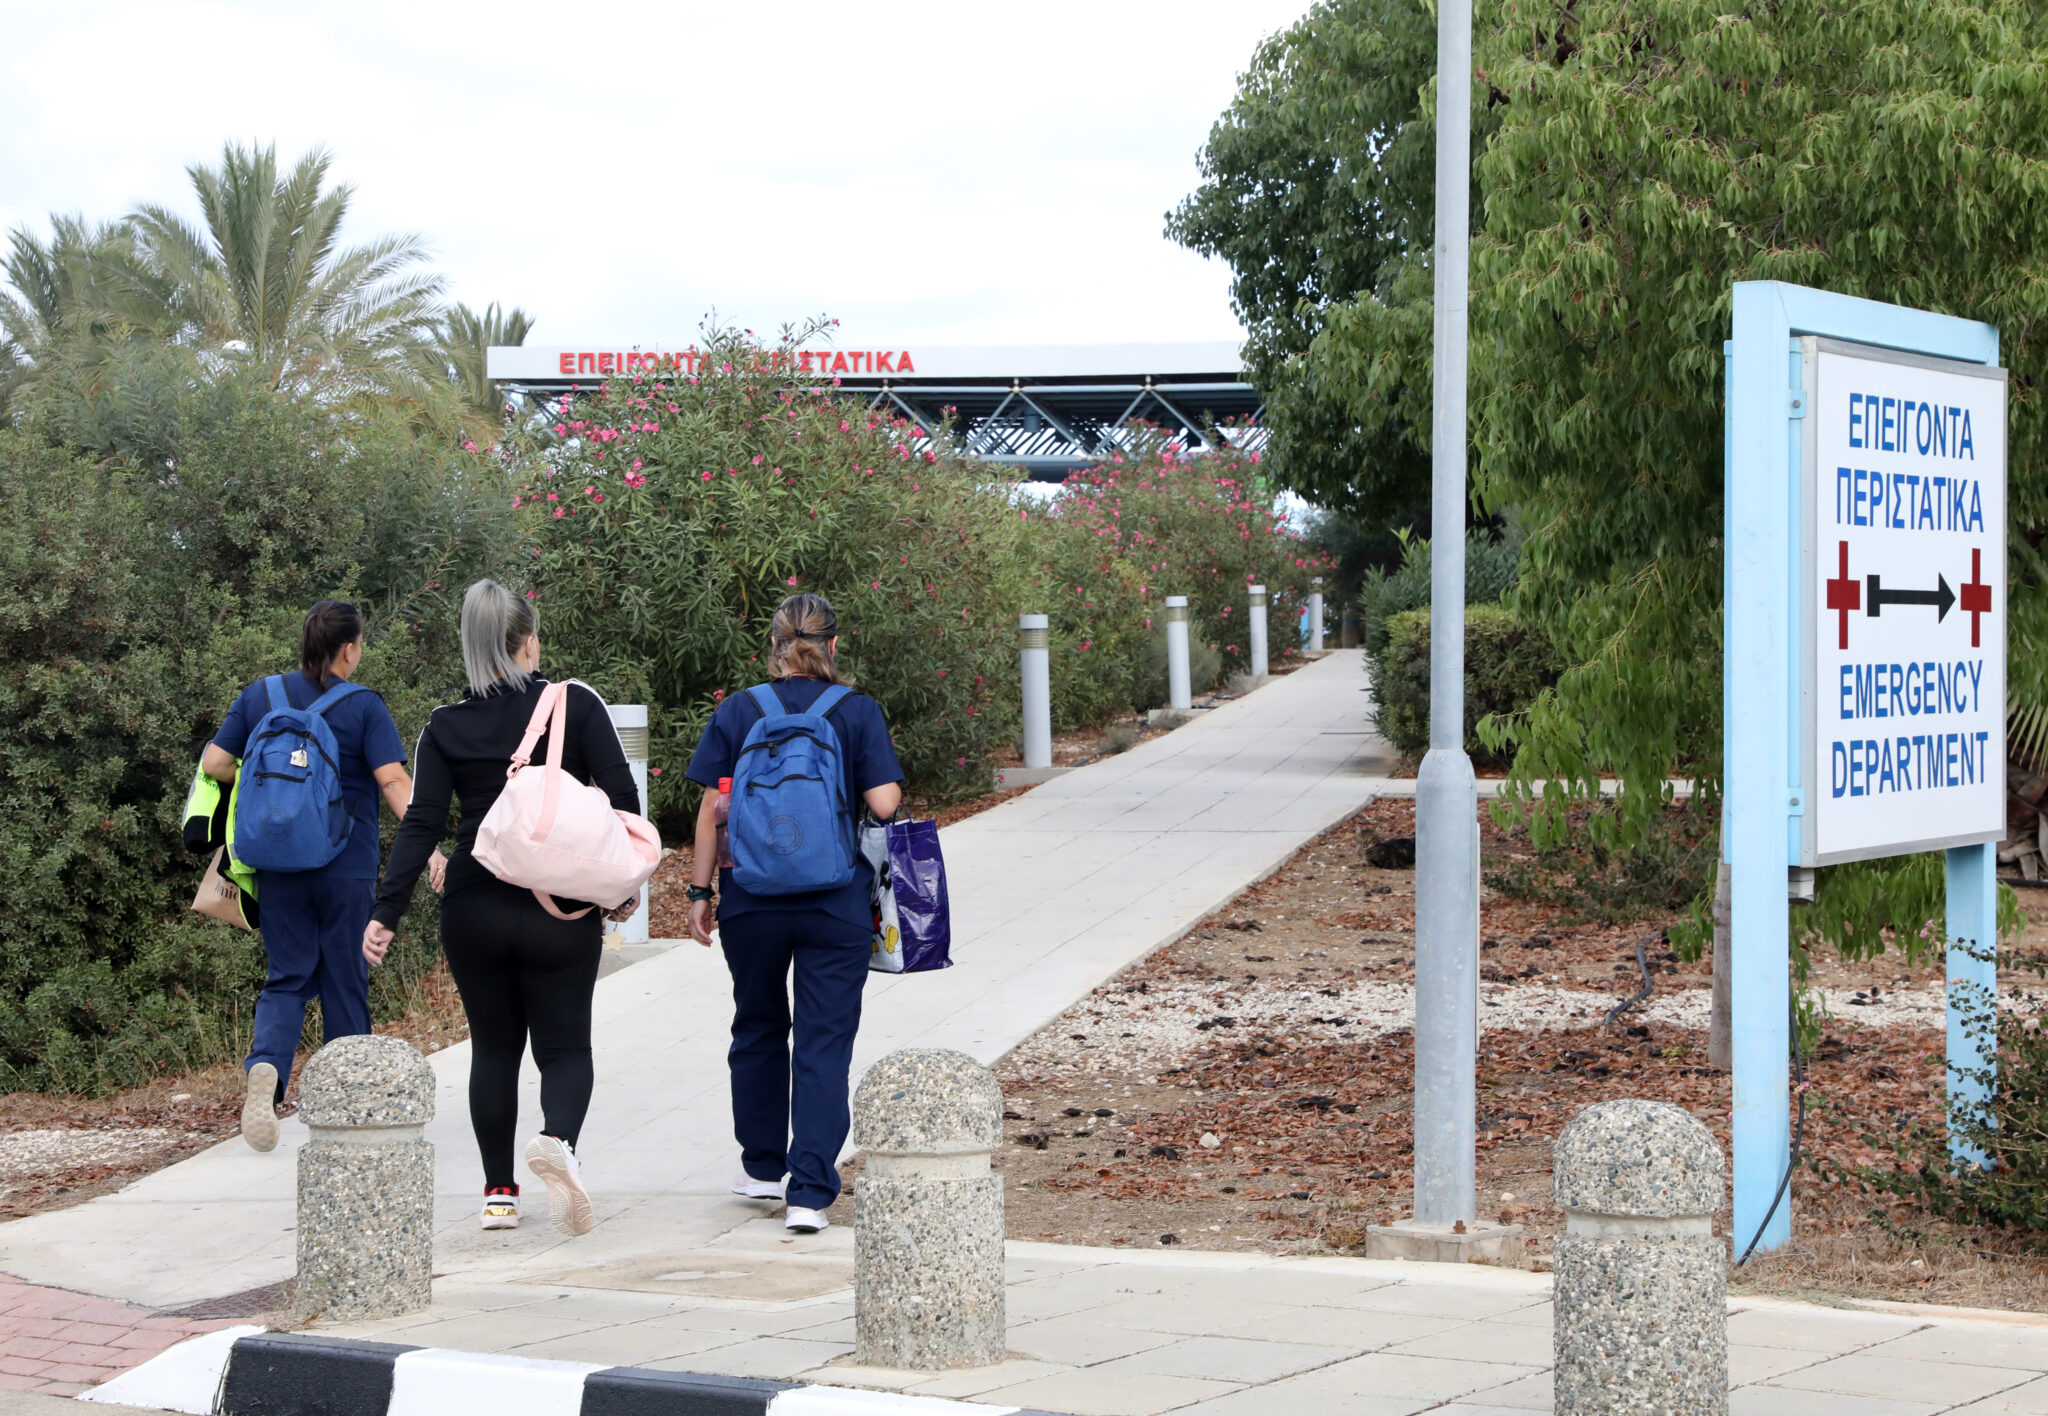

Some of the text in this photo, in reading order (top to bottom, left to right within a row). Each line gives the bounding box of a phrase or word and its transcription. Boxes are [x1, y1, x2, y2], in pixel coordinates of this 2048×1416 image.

[1849, 392, 1974, 461] ΕΠΕΙΓΟΝΤΑ
[1836, 466, 1984, 533] ΠΕΡΙΣΤΑΤΙΚΑ
[1840, 659, 1983, 720] EMERGENCY
[1832, 731, 1989, 799] DEPARTMENT
